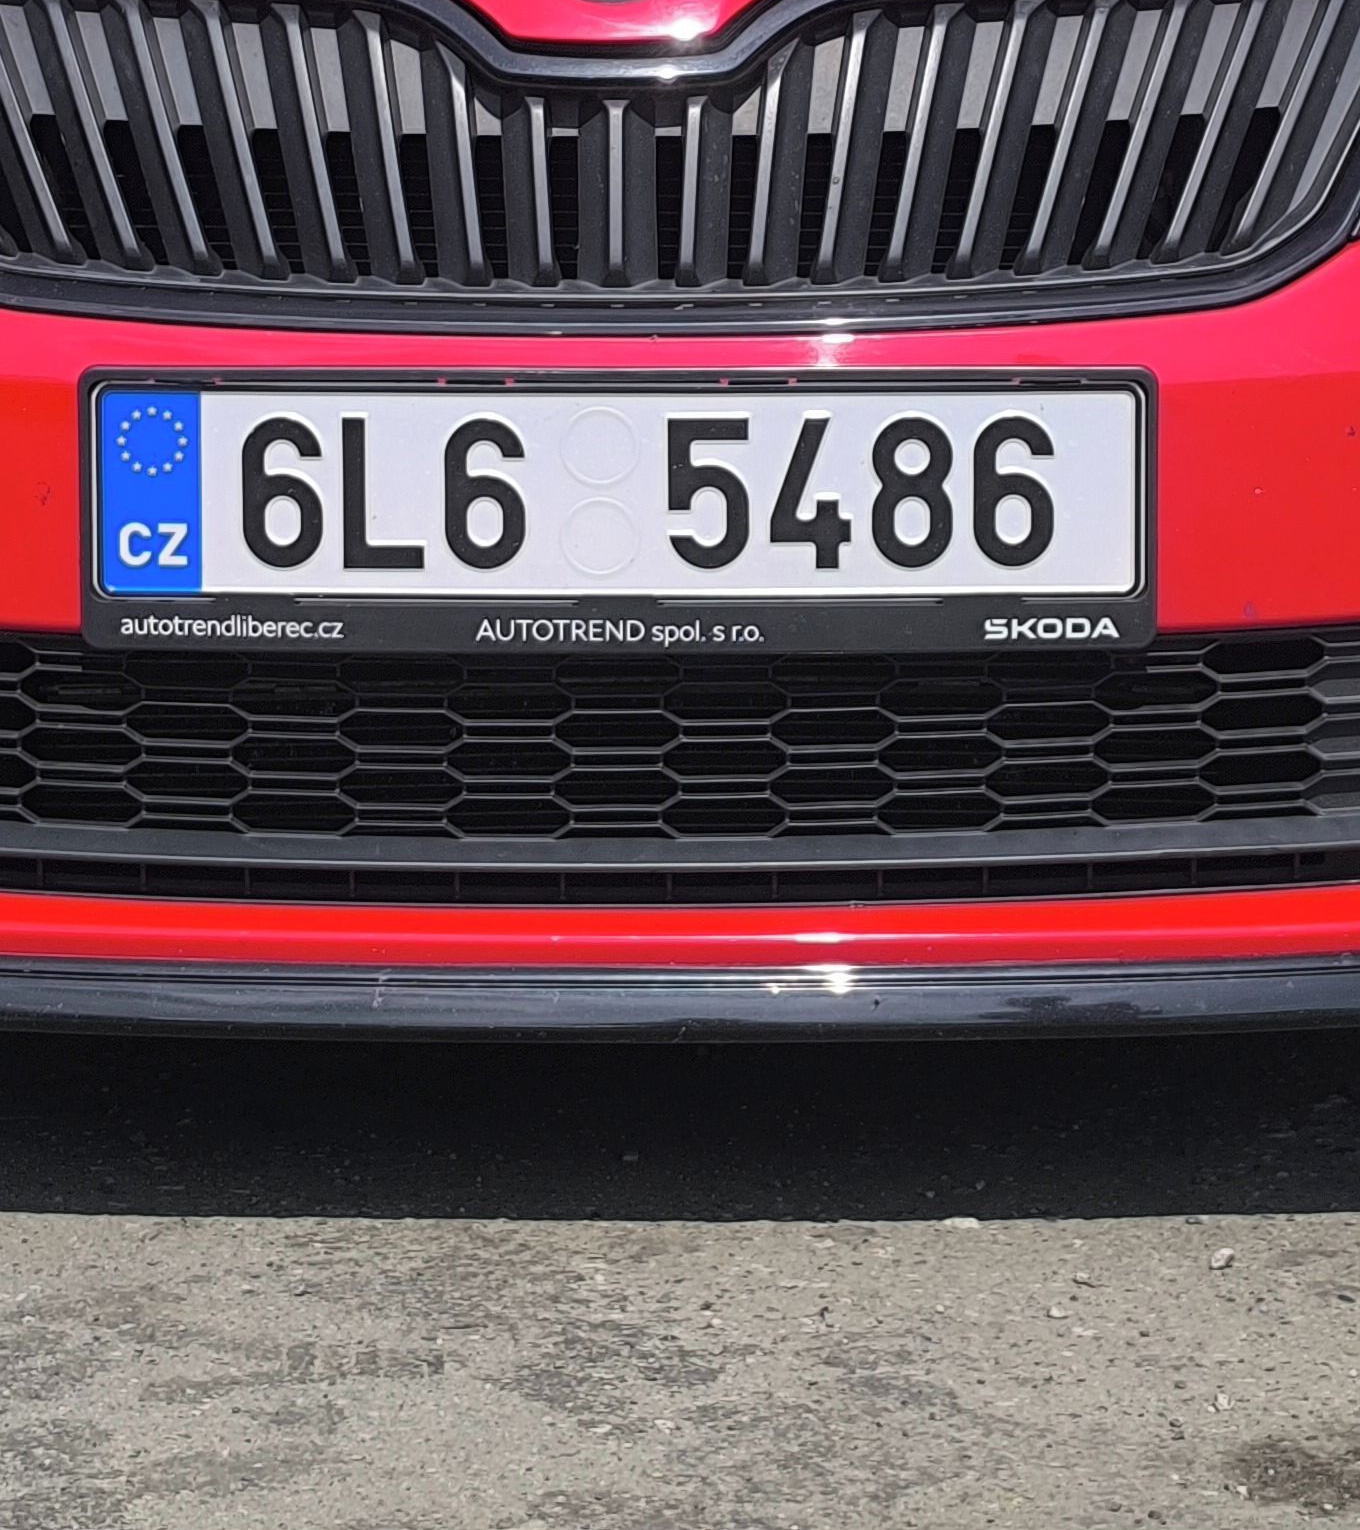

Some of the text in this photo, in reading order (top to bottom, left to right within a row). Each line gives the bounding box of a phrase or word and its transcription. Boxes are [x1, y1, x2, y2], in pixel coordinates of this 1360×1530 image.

[241, 414, 1056, 570] 6L6 5486
[119, 521, 188, 566] CZ
[120, 614, 344, 639] autotrendliberec.cz
[475, 618, 764, 647] AUTOTREND spol. s r.o.
